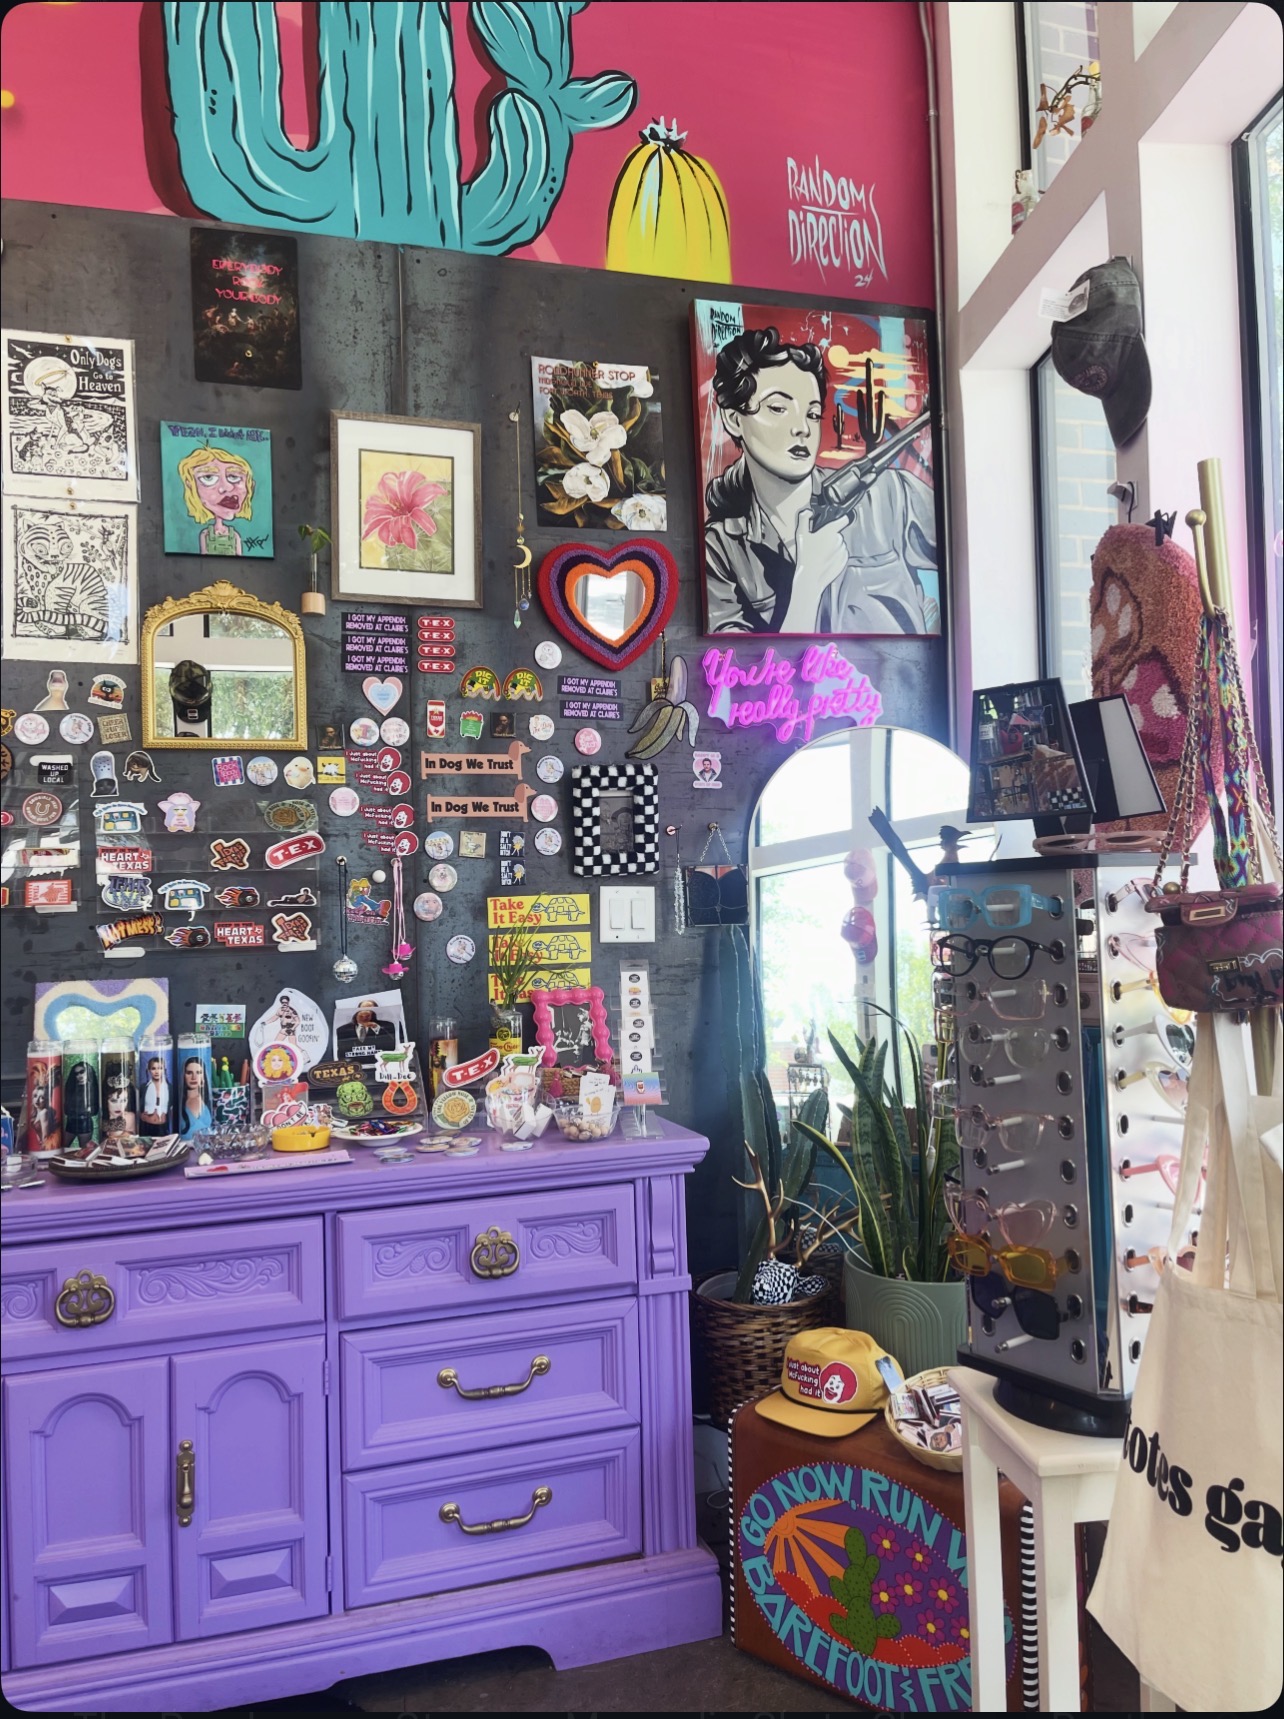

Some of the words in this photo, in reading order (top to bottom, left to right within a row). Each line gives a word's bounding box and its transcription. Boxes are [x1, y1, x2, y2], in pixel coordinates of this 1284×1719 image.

[787, 155, 866, 201] RANDOM
[787, 188, 888, 282] DIRECTION
[70, 349, 97, 369] Only
[96, 351, 122, 370] Dogs
[92, 372, 104, 380] Go
[105, 371, 114, 380] to
[608, 370, 636, 381] STOP
[79, 376, 121, 392] Heaven
[352, 614, 365, 622] GOT
[366, 614, 376, 623] MY
[346, 622, 373, 630] REMOVED
[375, 623, 382, 631] AT
[352, 636, 365, 644] GOT
[366, 636, 376, 645] MY
[346, 644, 373, 652] REMOVED
[375, 645, 382, 653] AT
[351, 655, 365, 663] GOT
[366, 656, 376, 664] MY
[345, 662, 373, 671] REMOVED
[375, 664, 382, 672] AT
[475, 671, 492, 680] DIG
[517, 672, 534, 681] DIG
[702, 648, 797, 715] You're
[561, 685, 587, 693] REMOVED
[569, 702, 581, 710] GOT
[728, 685, 801, 743] really
[803, 677, 882, 742] pretty
[563, 709, 588, 717] REMOVED
[425, 758, 436, 769] In
[439, 759, 462, 771] Dog
[466, 758, 484, 769] We
[487, 758, 513, 769] Trust
[431, 801, 442, 812] In
[445, 802, 468, 814] Dog
[472, 802, 490, 812] We
[493, 801, 519, 812] Trust
[101, 853, 139, 861] HEART
[490, 898, 524, 911] Take
[493, 912, 505, 924] It
[508, 911, 542, 925] Easy
[217, 927, 253, 936] HEART
[227, 936, 263, 944] TEXAS
[314, 1065, 355, 1079] TEXAS
[800, 1363, 820, 1375] about
[788, 1370, 819, 1387] McFucking
[800, 1385, 813, 1395] had
[815, 1389, 821, 1398] it
[740, 1493, 776, 1547] GO
[861, 1469, 943, 1546] RUN
[1205, 1477, 1284, 1557] ga
[742, 1554, 899, 1710] BAREFOOT
